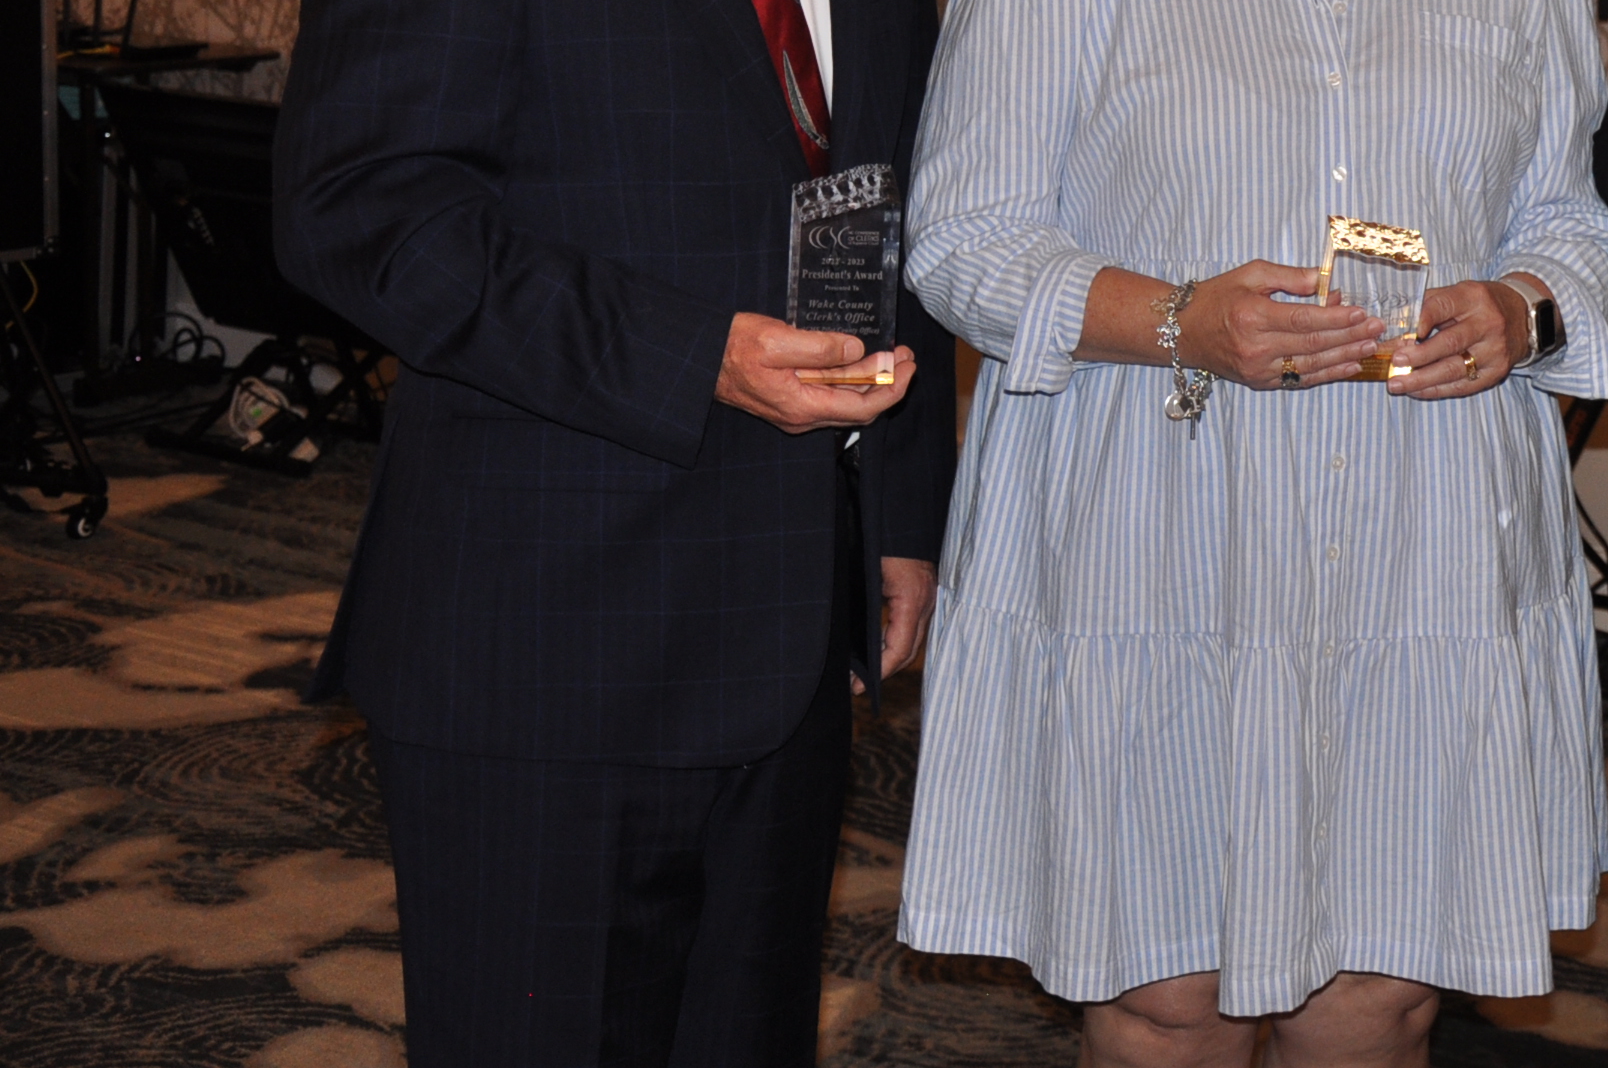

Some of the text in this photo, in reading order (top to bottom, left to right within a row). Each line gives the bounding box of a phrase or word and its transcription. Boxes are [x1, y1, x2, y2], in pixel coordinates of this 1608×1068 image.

[847, 258, 865, 266] 2023
[802, 269, 883, 280] President's Award
[808, 299, 873, 311] Wake County
[805, 312, 876, 324] Clerk's Office
